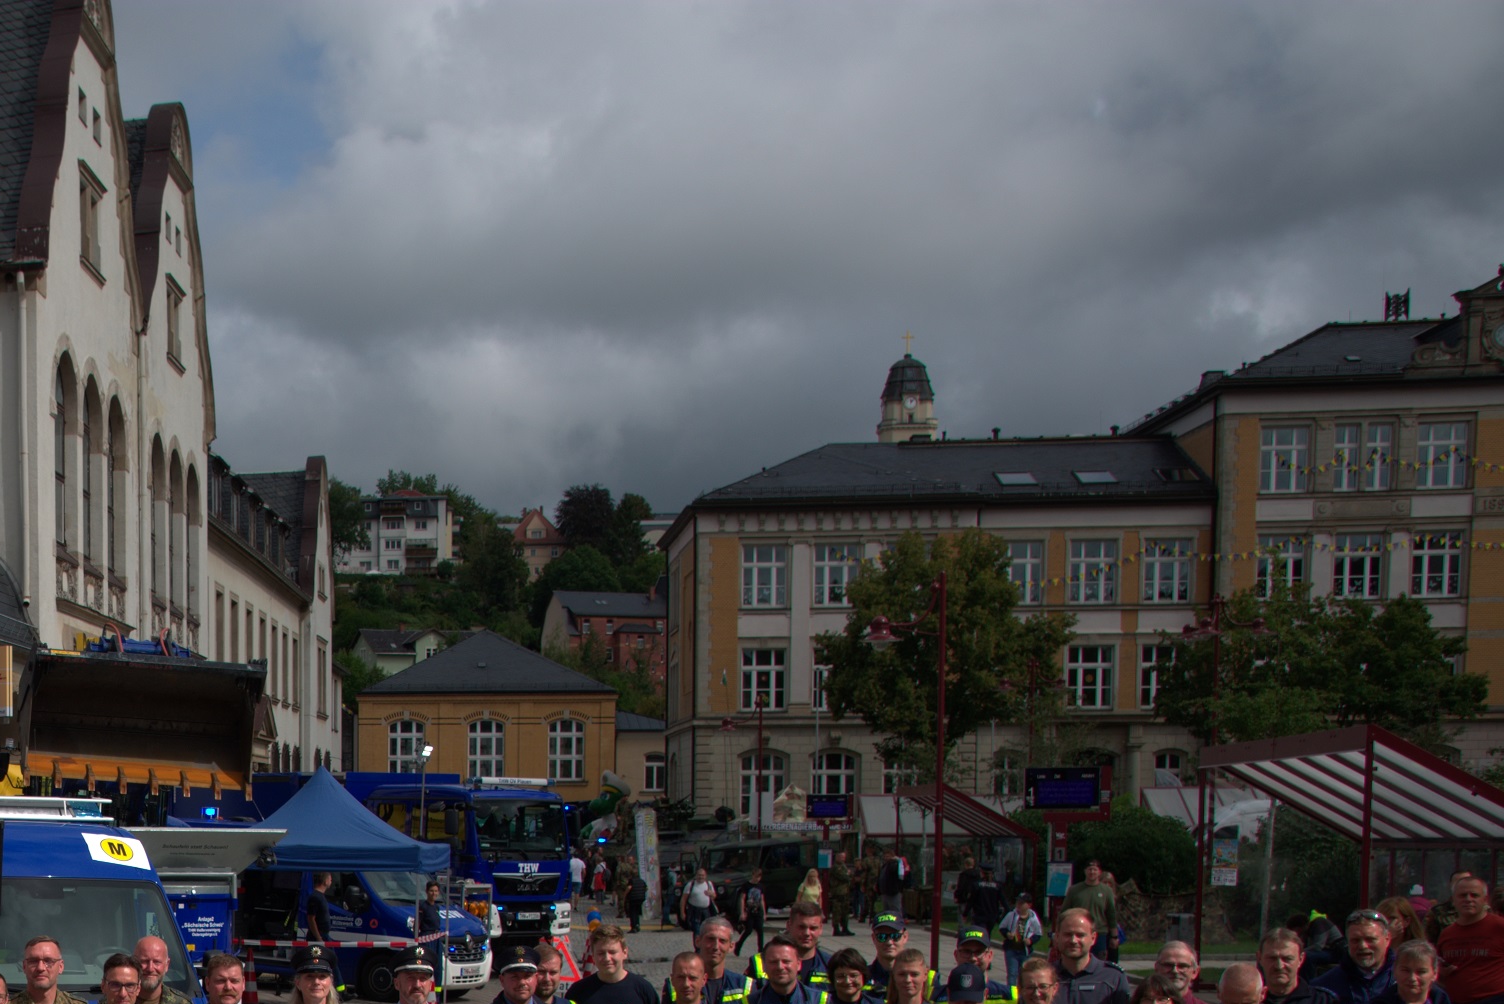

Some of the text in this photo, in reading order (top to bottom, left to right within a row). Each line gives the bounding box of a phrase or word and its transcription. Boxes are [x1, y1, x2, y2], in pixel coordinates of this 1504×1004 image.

[107, 841, 128, 857] M
[517, 862, 541, 873] THW
[877, 914, 897, 923] THW
[965, 930, 984, 938] THW
